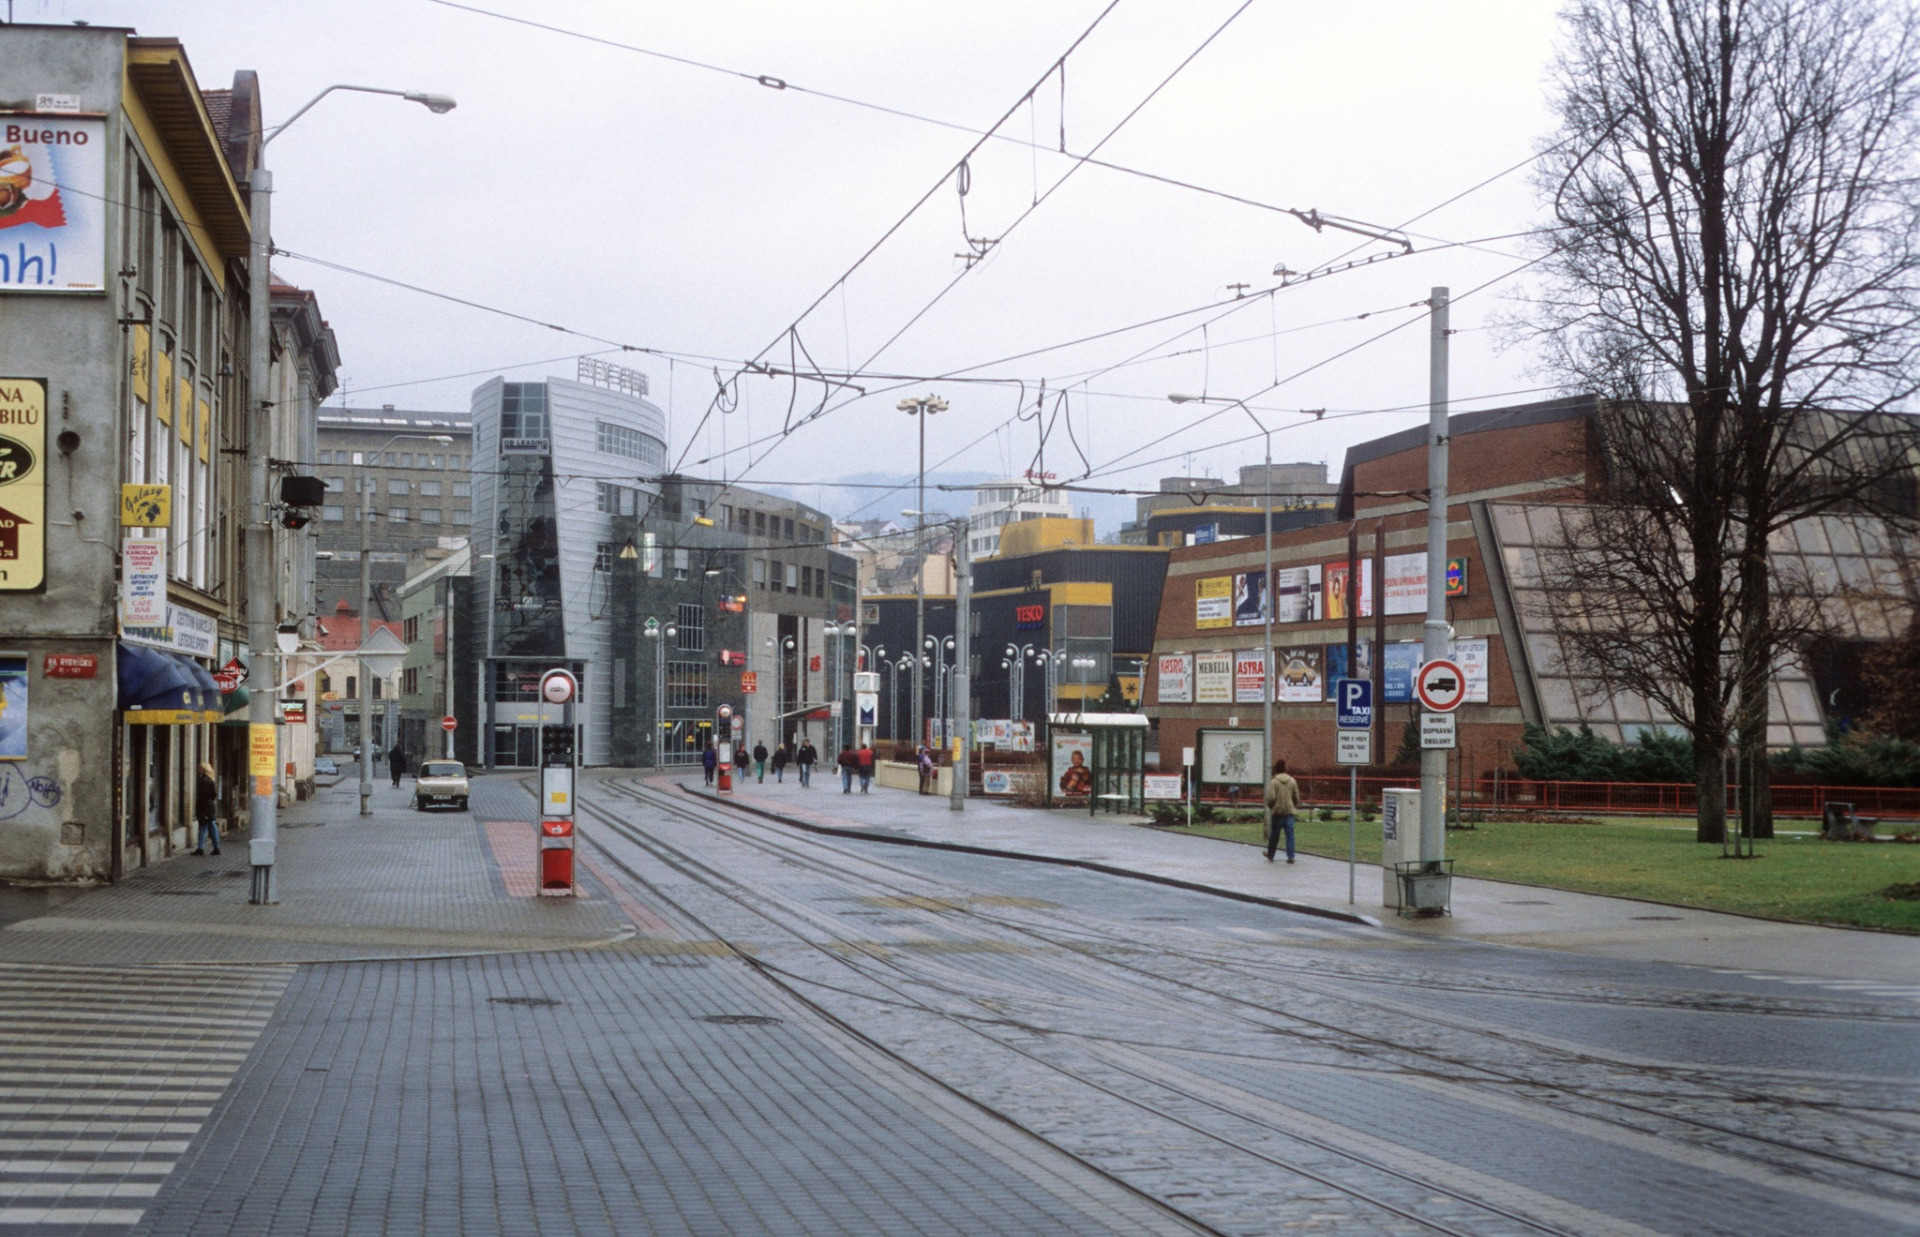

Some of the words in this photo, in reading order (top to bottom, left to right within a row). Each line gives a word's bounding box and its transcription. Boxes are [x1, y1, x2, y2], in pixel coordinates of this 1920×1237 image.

[6, 125, 89, 145] Bueno
[0, 461, 17, 478] R
[1016, 604, 1044, 622] TESCO
[1160, 659, 1184, 675] KASRO
[1237, 661, 1264, 675] ASTRA
[1347, 684, 1362, 709] P
[281, 702, 304, 711] ergizer
[1352, 706, 1370, 715] TAXI
